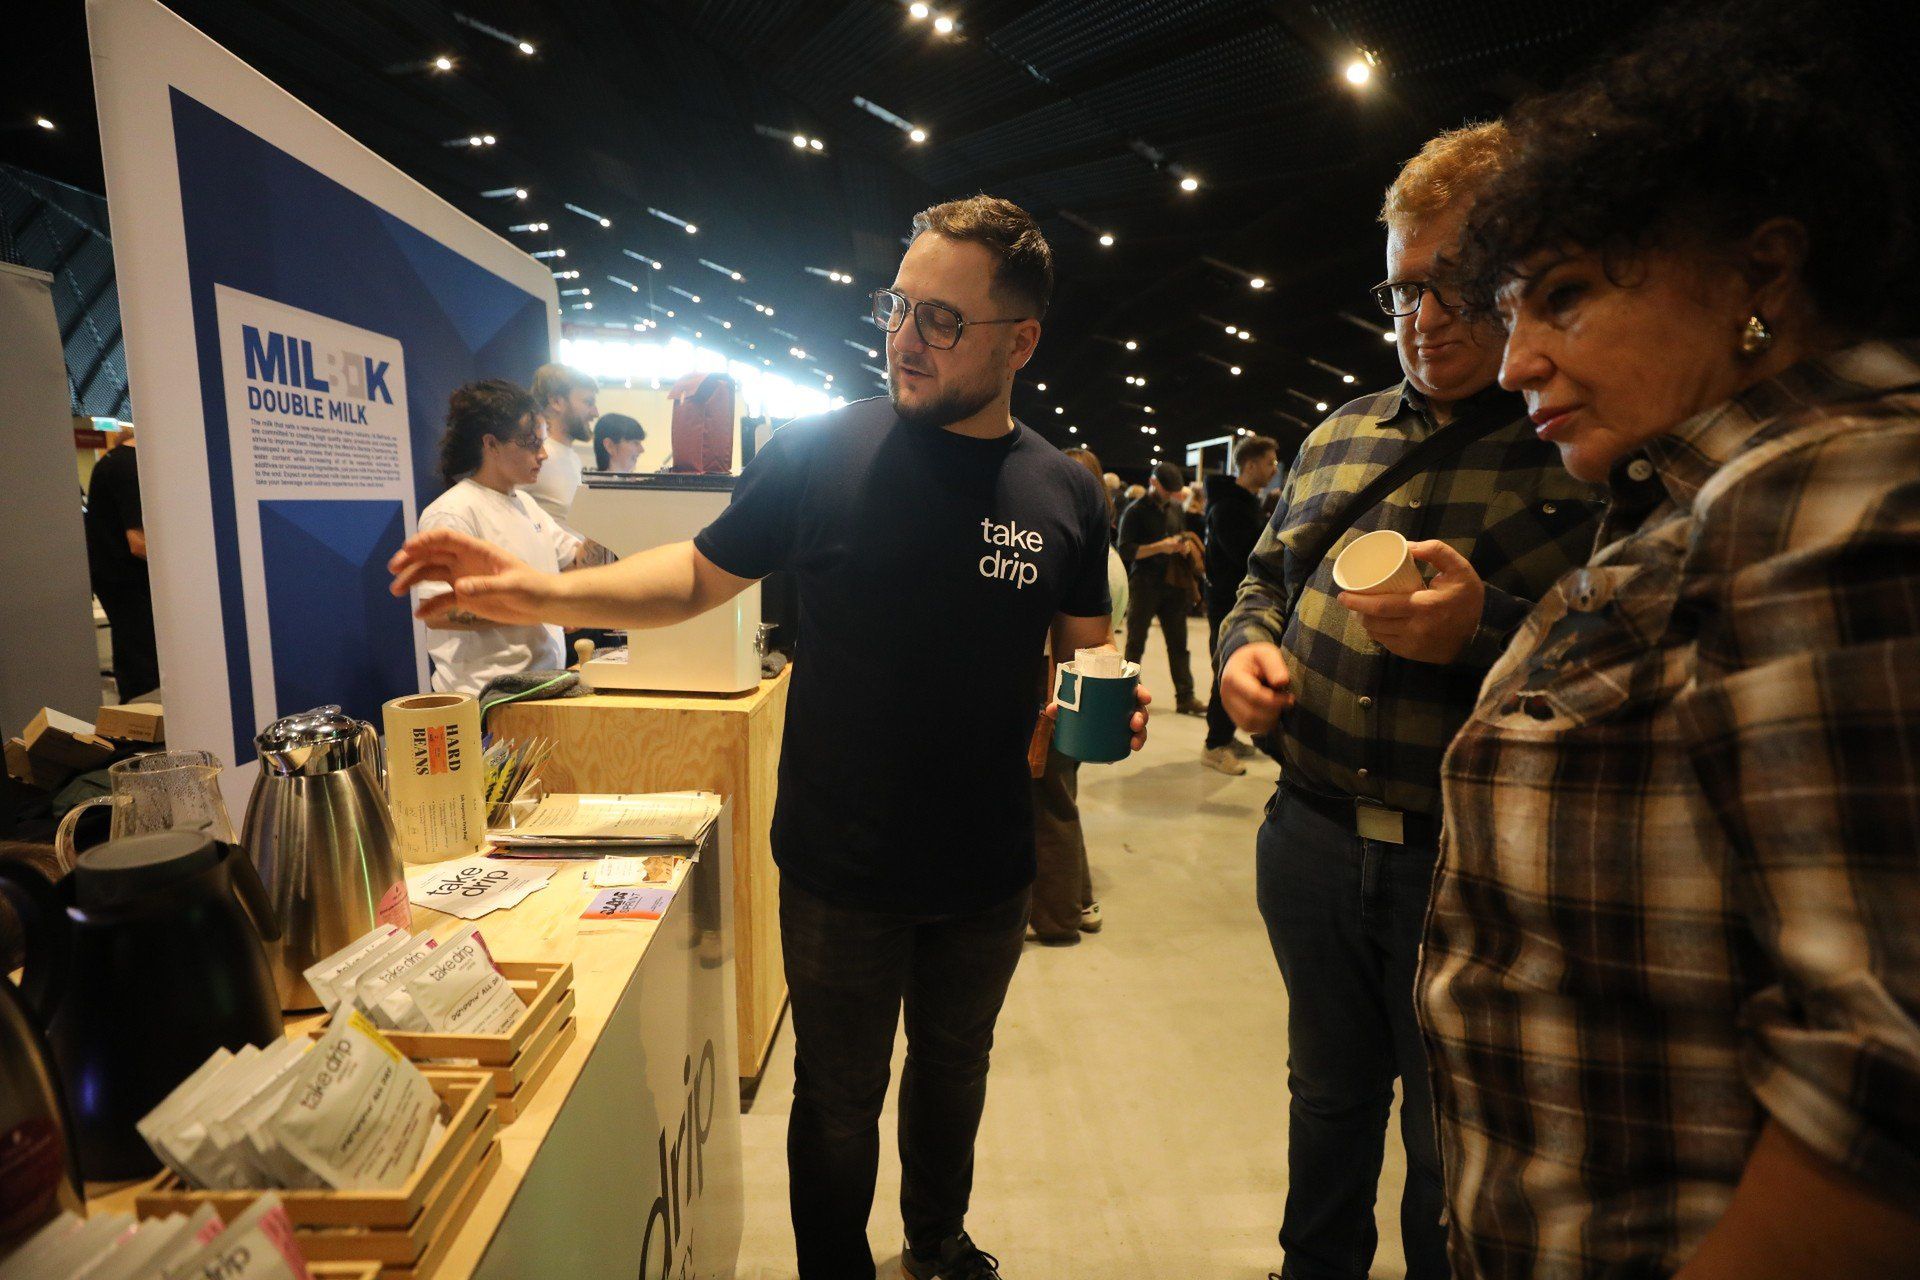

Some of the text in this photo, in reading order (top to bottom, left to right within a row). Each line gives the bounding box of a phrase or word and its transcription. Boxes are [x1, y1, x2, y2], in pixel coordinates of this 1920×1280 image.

[248, 386, 368, 425] DOUBLE MILK
[980, 517, 1043, 553] take
[979, 549, 1038, 590] drip
[412, 728, 429, 776] BEANS
[446, 724, 461, 772] HARD
[426, 867, 483, 897] take
[461, 870, 509, 897] drip
[430, 960, 456, 982] take
[454, 943, 474, 966] drip
[300, 1072, 332, 1110] take
[326, 1039, 352, 1072] drip
[638, 1038, 716, 1280] drip
